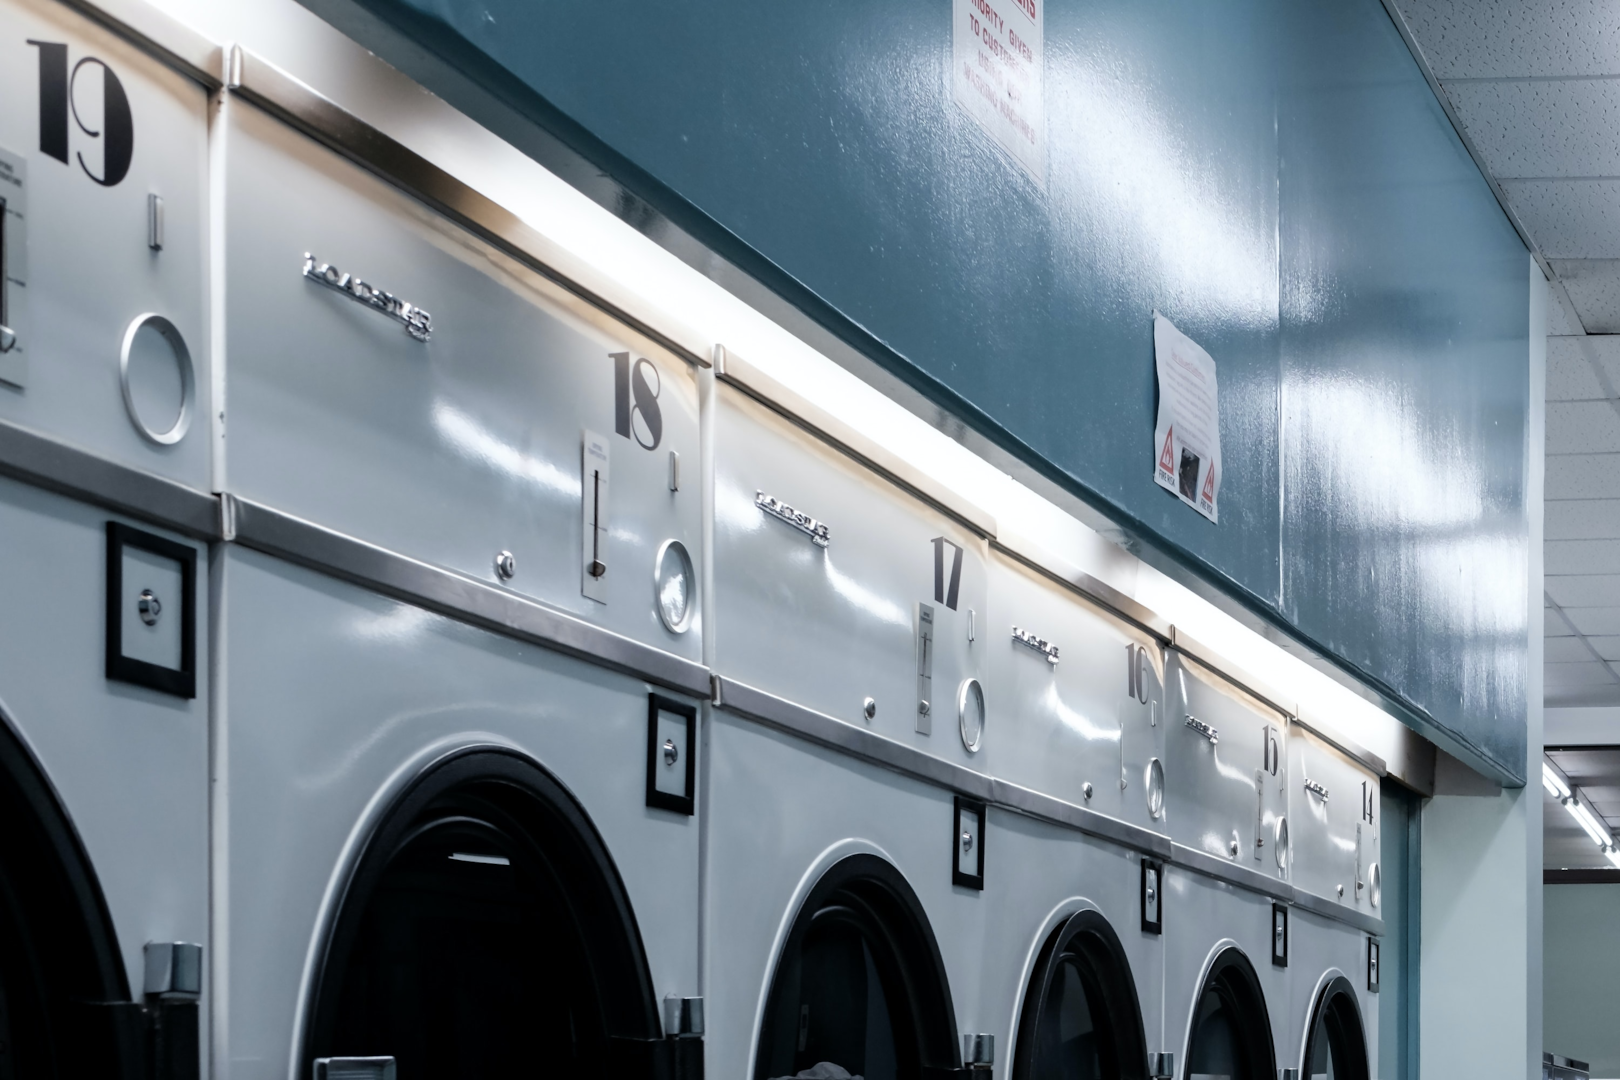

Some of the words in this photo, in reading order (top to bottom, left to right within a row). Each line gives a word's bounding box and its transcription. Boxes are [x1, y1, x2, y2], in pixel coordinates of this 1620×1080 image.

[969, 12, 980, 36] TO
[1009, 28, 1033, 64] GIVEN
[26, 38, 134, 188] 19
[302, 251, 434, 332] LOADSTAR
[607, 351, 663, 452] 18
[1158, 468, 1167, 482] FIRE
[1166, 474, 1176, 488] RISK
[930, 536, 964, 612] 17
[1125, 642, 1149, 705] 16
[1262, 724, 1279, 777] 15
[1361, 780, 1374, 826] 14
